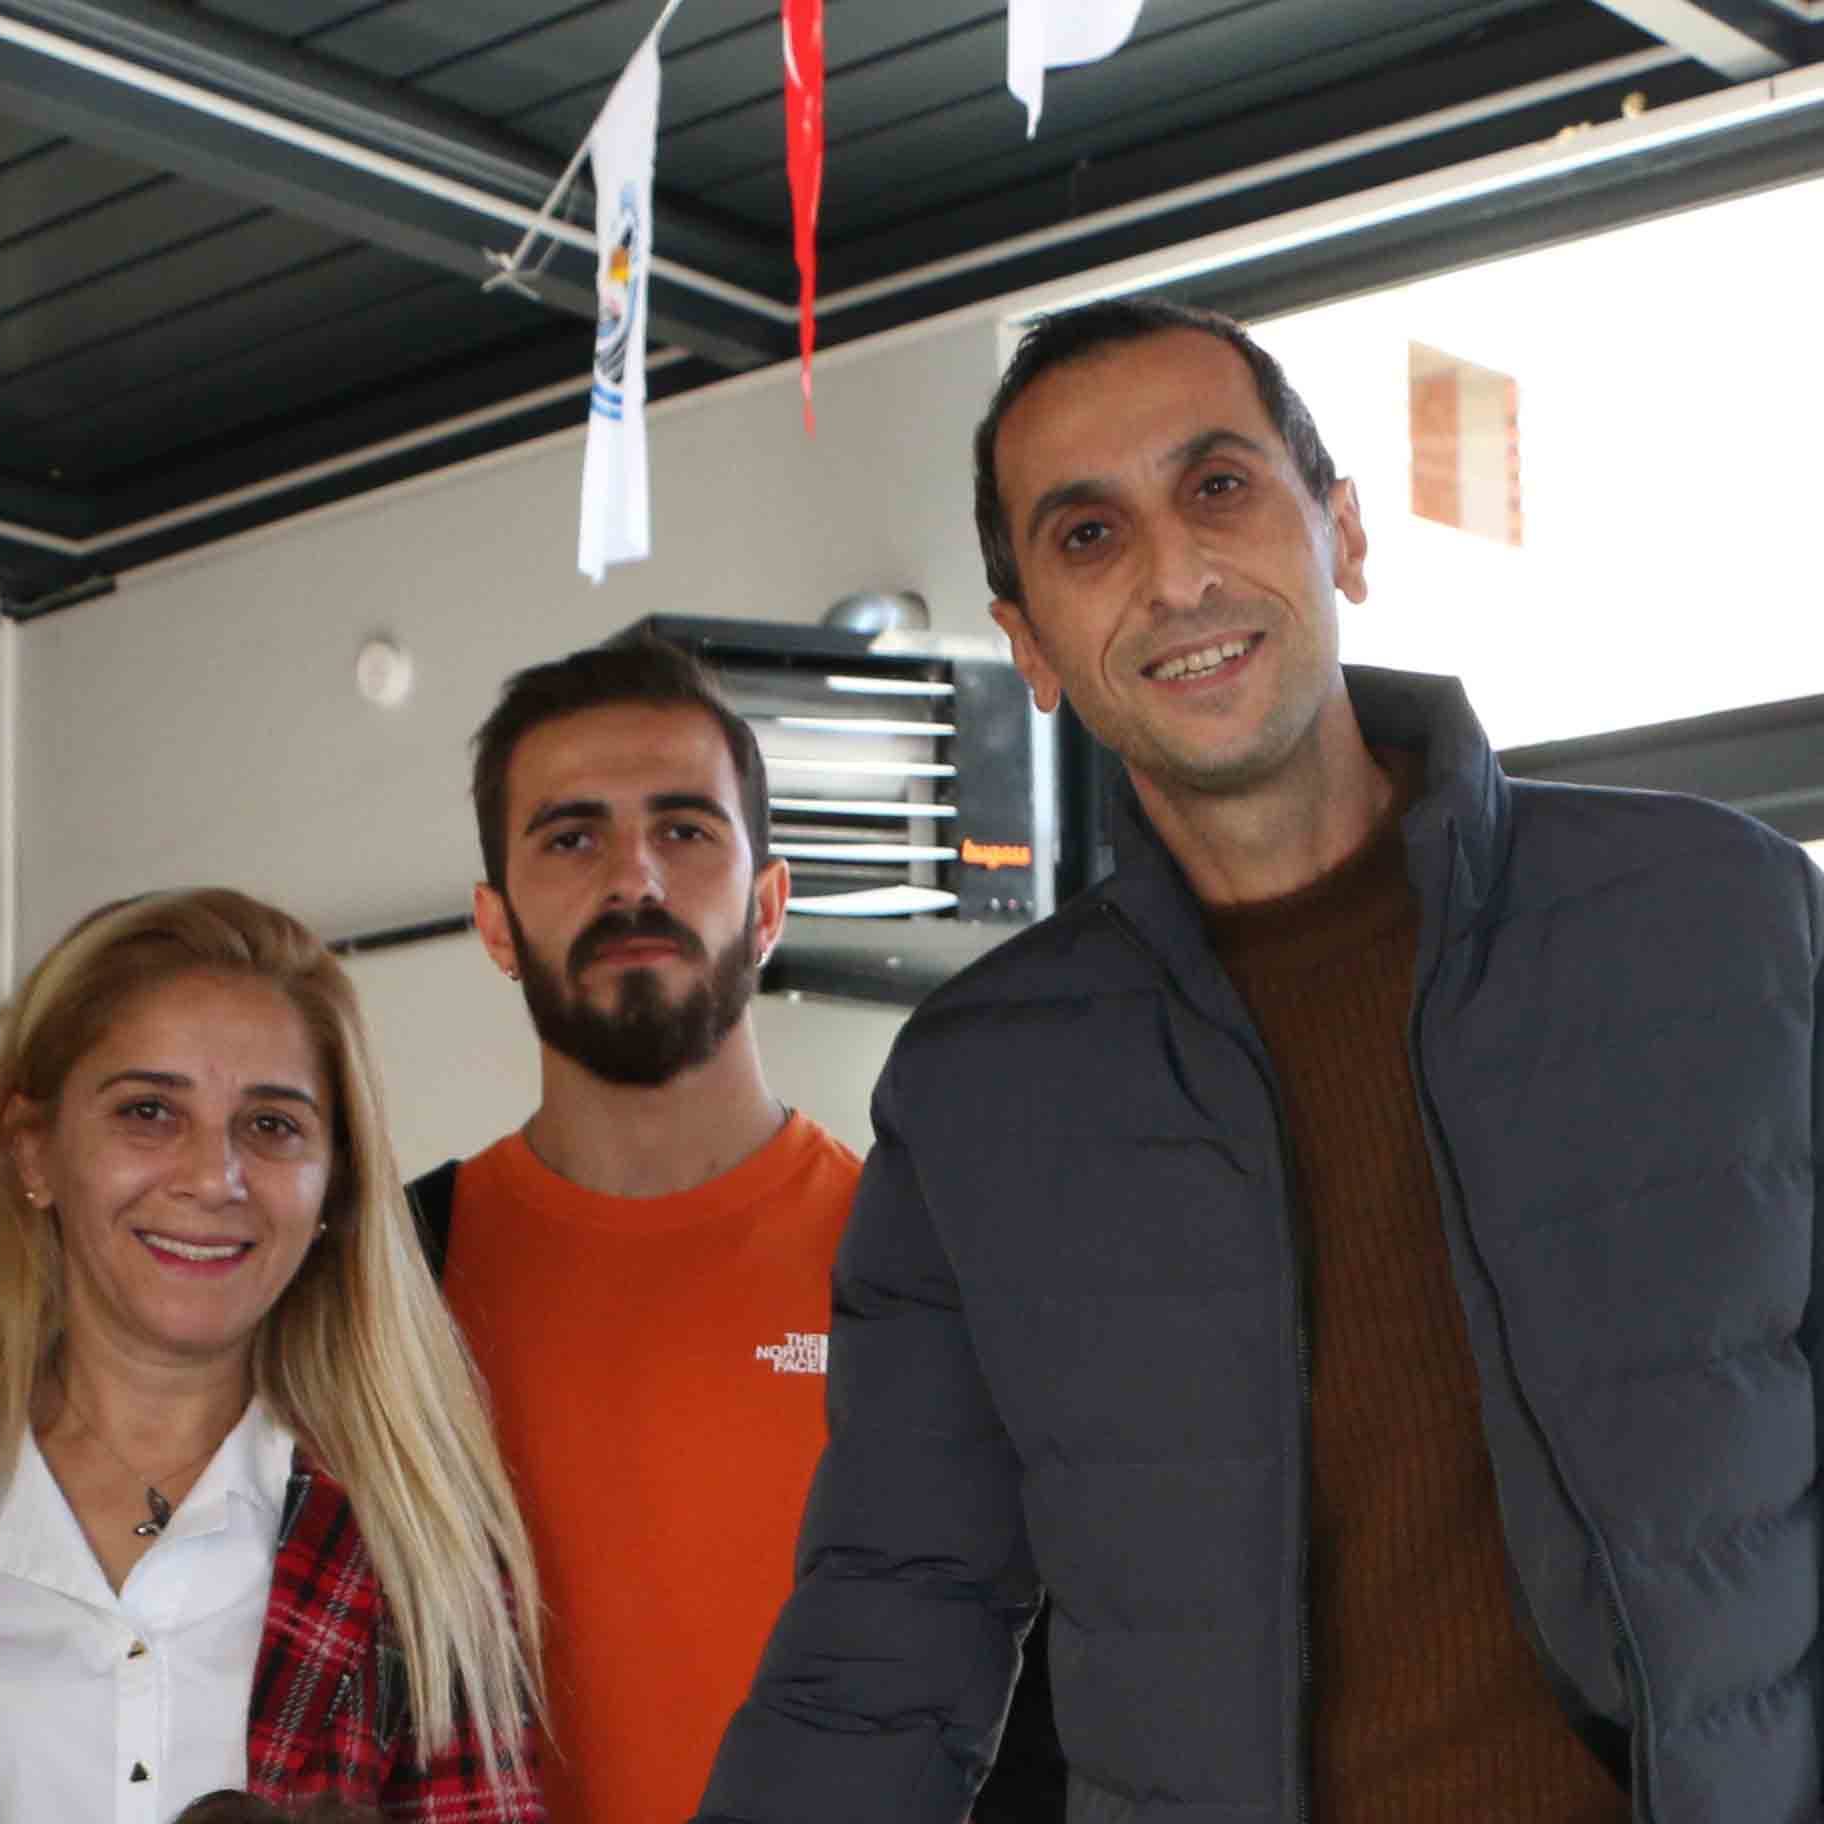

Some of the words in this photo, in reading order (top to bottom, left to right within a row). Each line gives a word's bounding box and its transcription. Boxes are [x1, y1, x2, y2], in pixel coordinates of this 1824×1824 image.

[784, 1333, 819, 1346] THE
[755, 1345, 819, 1361] NORTH
[773, 1360, 819, 1374] FACE
